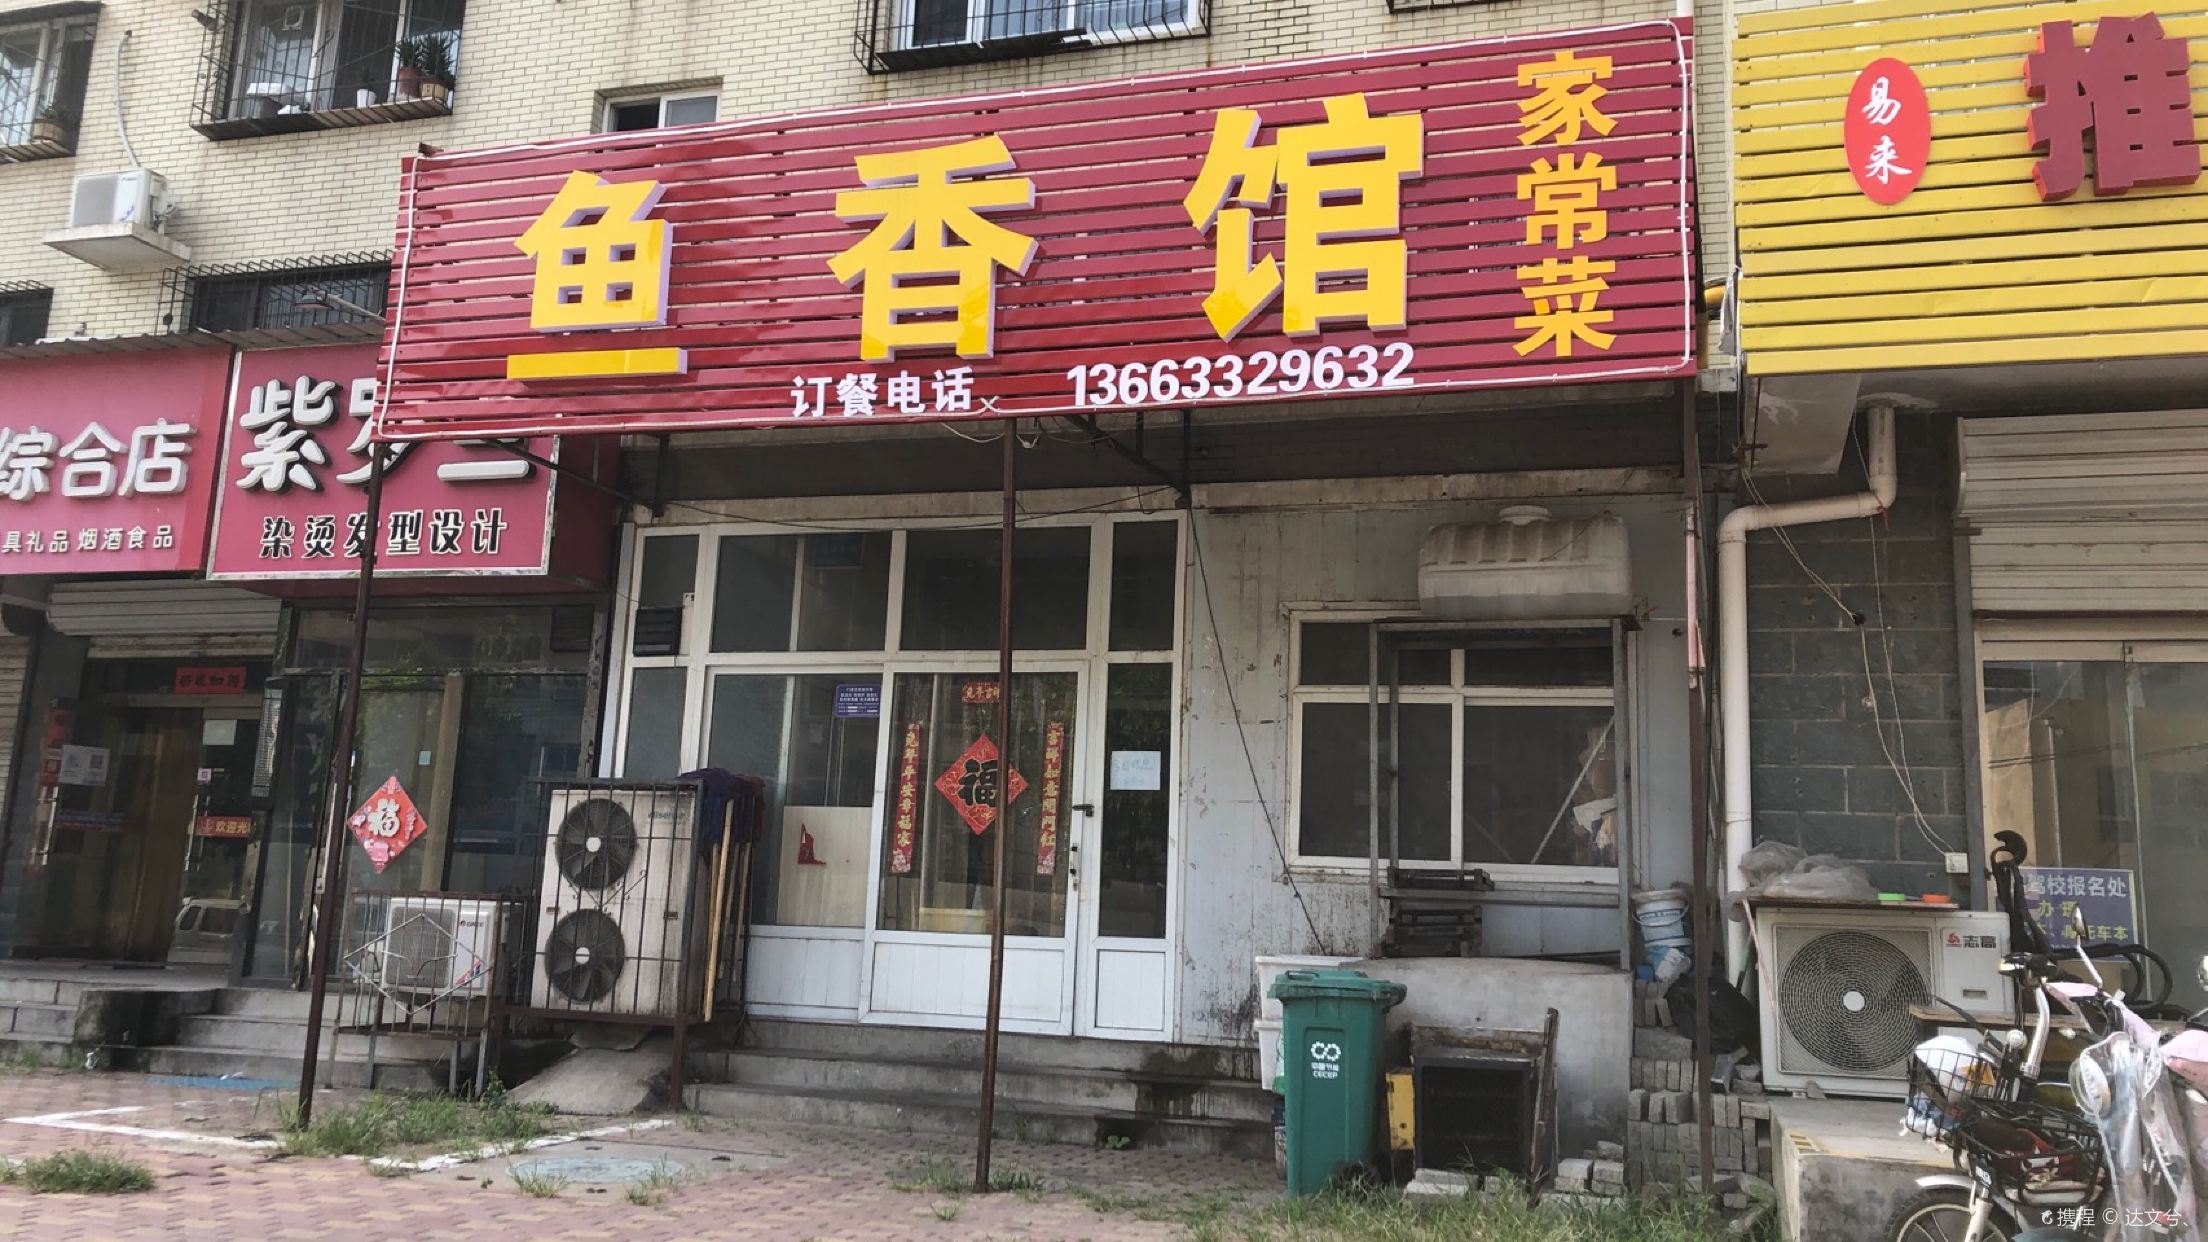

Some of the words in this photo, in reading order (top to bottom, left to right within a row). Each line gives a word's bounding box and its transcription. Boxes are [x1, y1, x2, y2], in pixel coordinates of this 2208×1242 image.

[1861, 75, 1912, 186] 易来
[2023, 12, 2202, 203] 推
[507, 93, 1425, 384] 鱼香馆
[1512, 49, 1619, 358] 家常菜
[790, 365, 975, 419] 订餐电话
[1065, 342, 1416, 407] 13663329632
[1, 530, 71, 553] 具礼品
[77, 524, 174, 551] 烟酒食品
[1963, 935, 1997, 949] 志高
